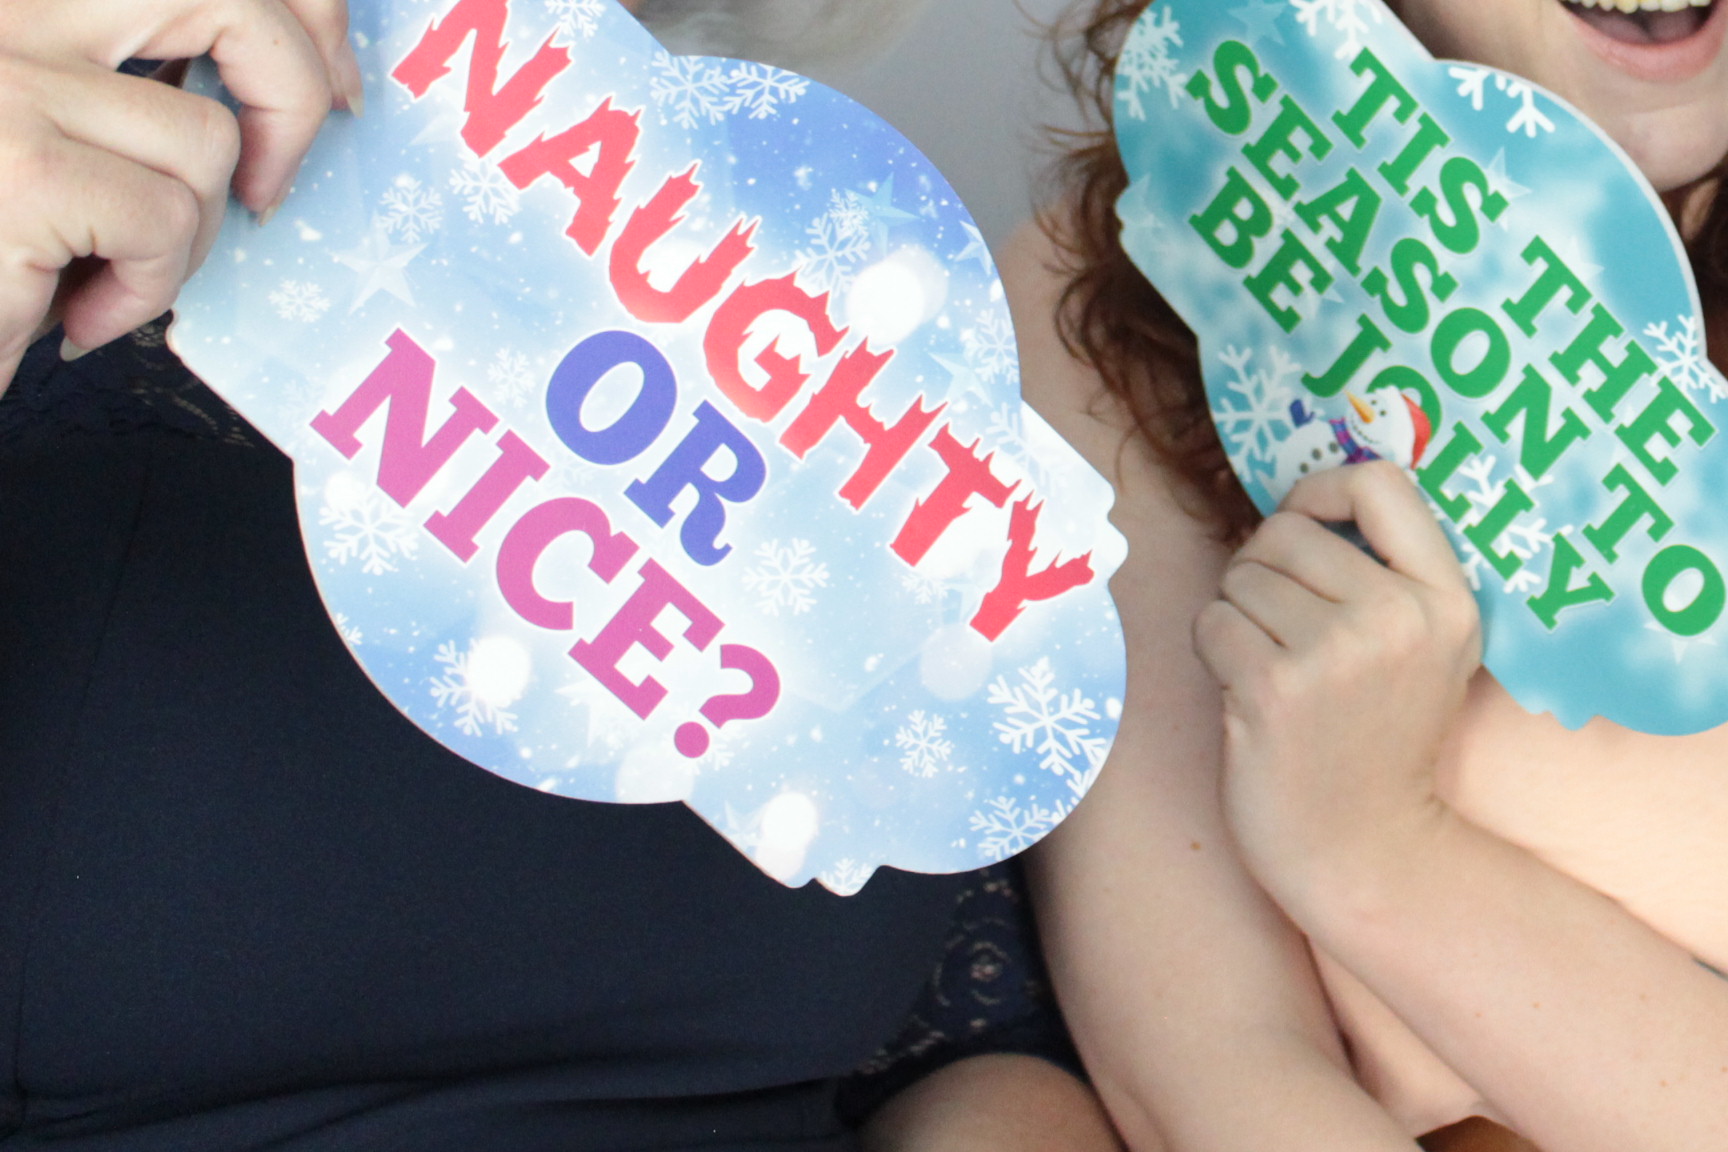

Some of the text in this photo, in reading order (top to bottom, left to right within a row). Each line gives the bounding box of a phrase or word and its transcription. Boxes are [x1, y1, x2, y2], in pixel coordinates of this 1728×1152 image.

[546, 330, 766, 566] OR
[1187, 41, 1726, 636] SEASON TO
[1190, 168, 1334, 333] BE
[1333, 48, 1716, 486] TIS THE
[310, 328, 781, 758] NICE?
